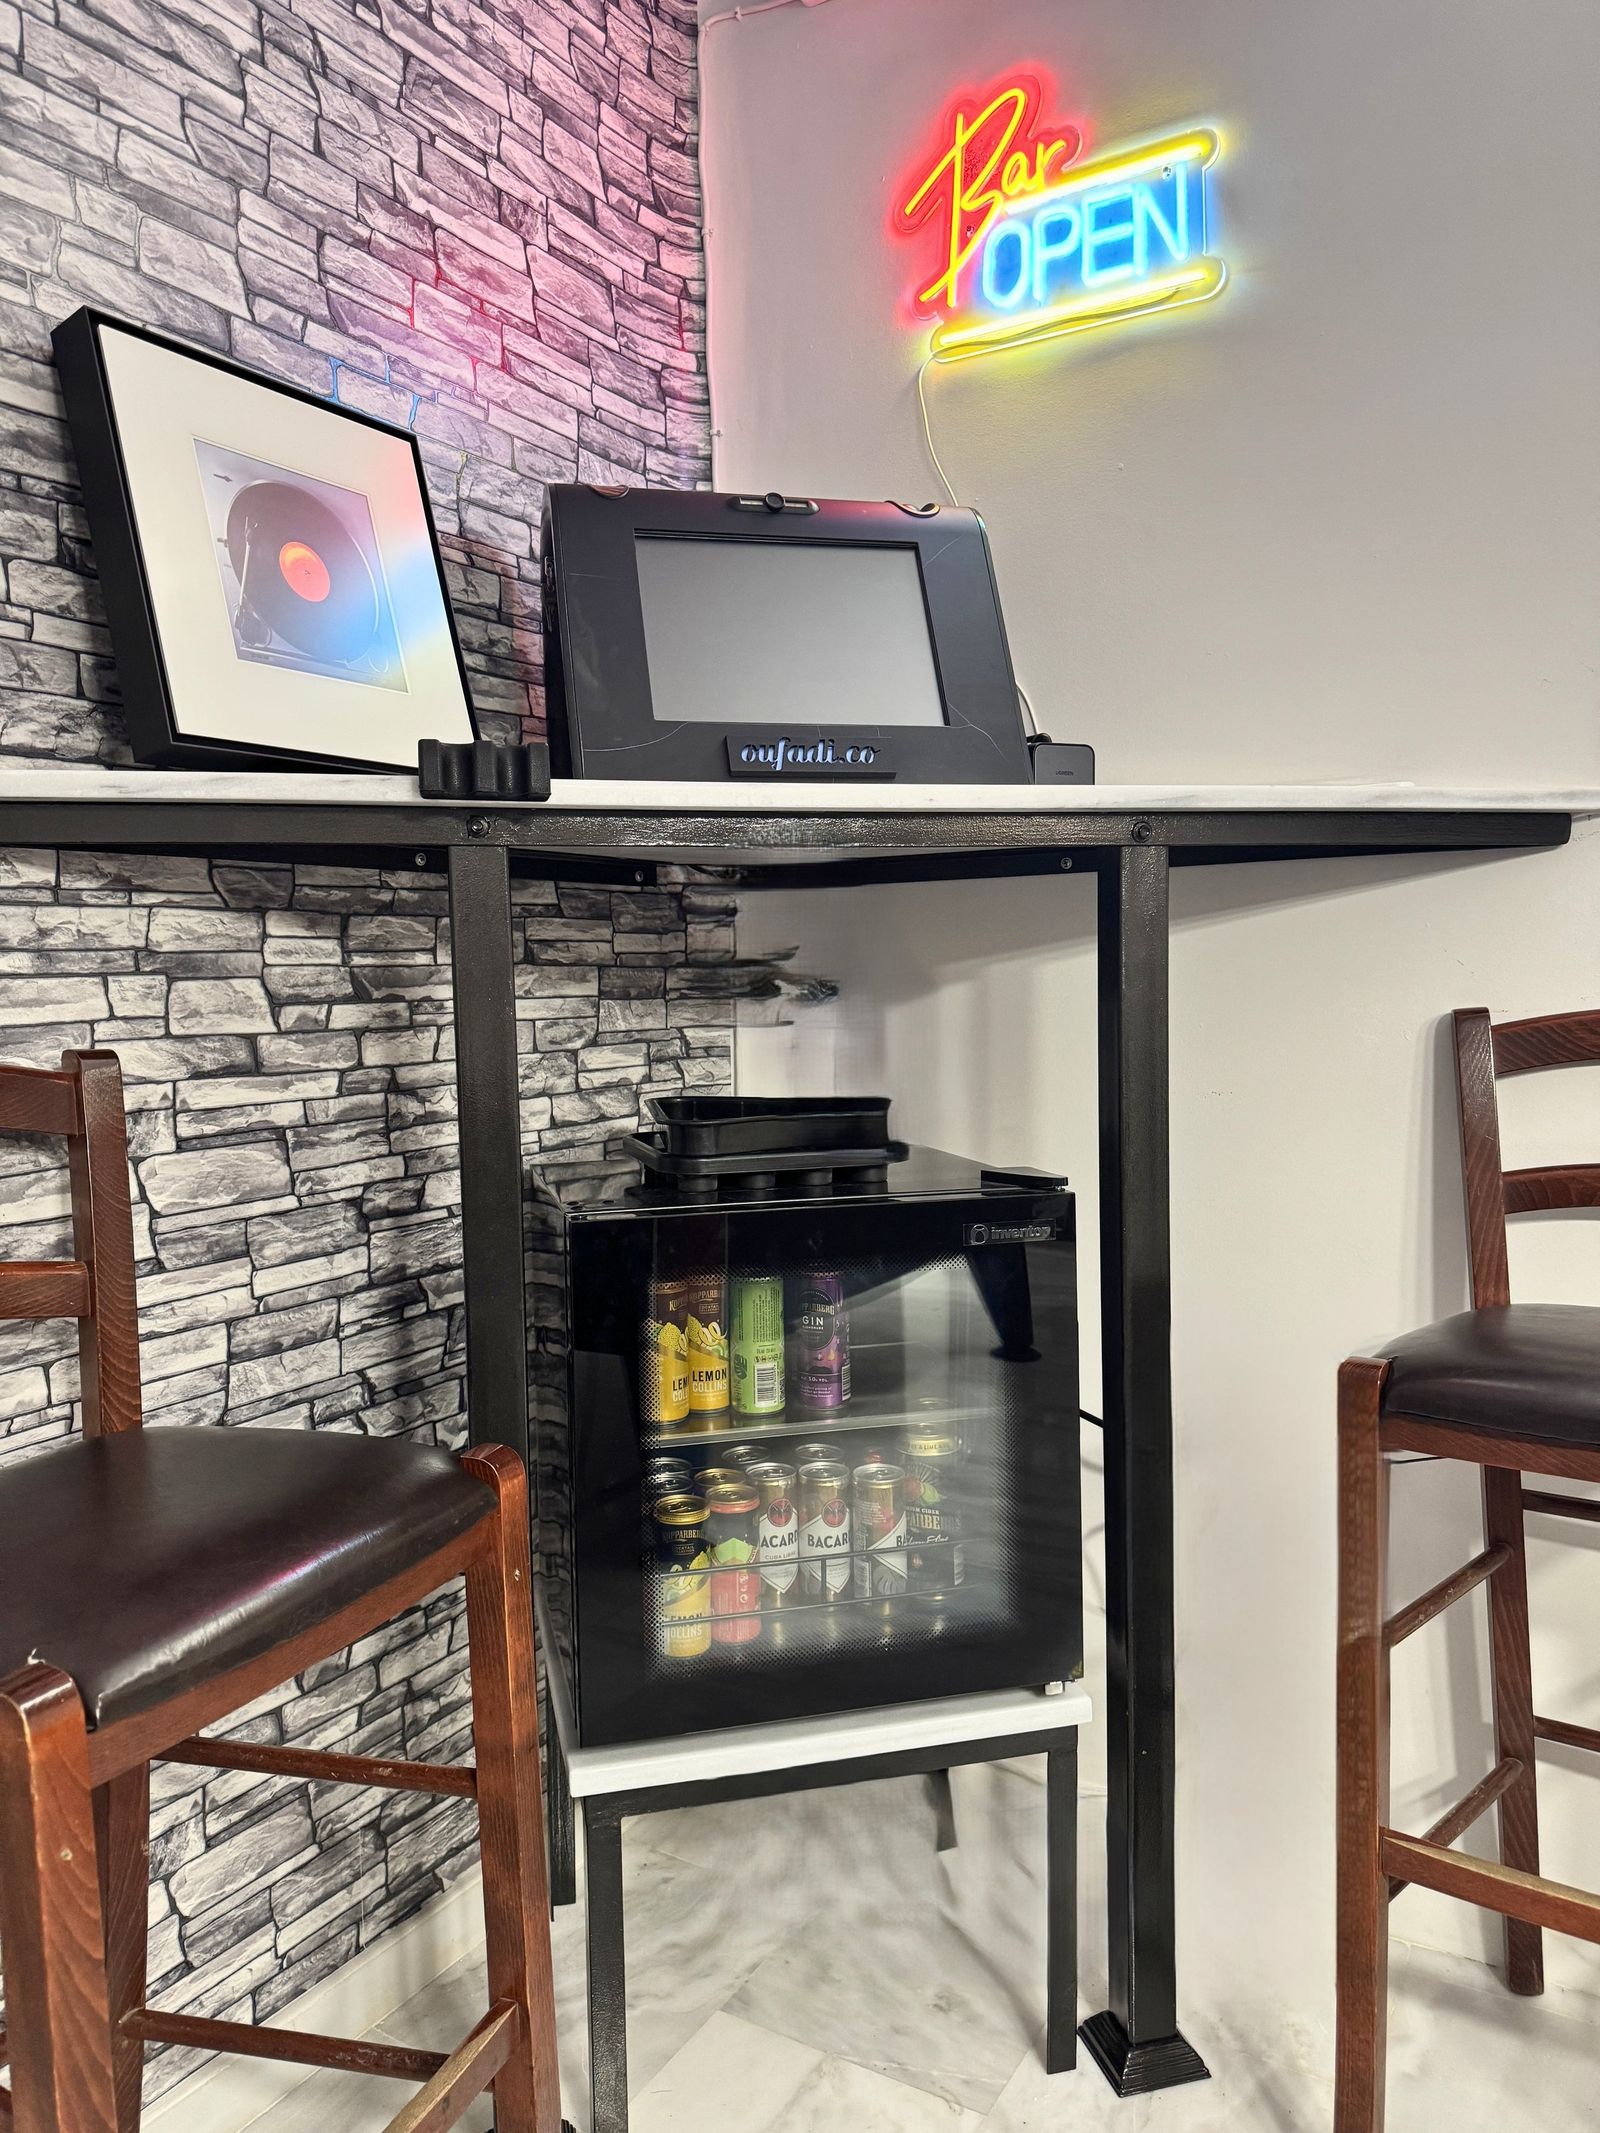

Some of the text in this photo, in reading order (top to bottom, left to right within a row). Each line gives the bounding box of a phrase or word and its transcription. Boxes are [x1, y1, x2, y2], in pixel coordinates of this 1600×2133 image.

[904, 87, 1067, 308] Bar
[982, 158, 1190, 308] OPEN
[740, 736, 881, 771] oufadi.co
[802, 1315, 824, 1326] GIN
[692, 1367, 728, 1382] LEMON
[692, 1380, 728, 1393] COLLINS
